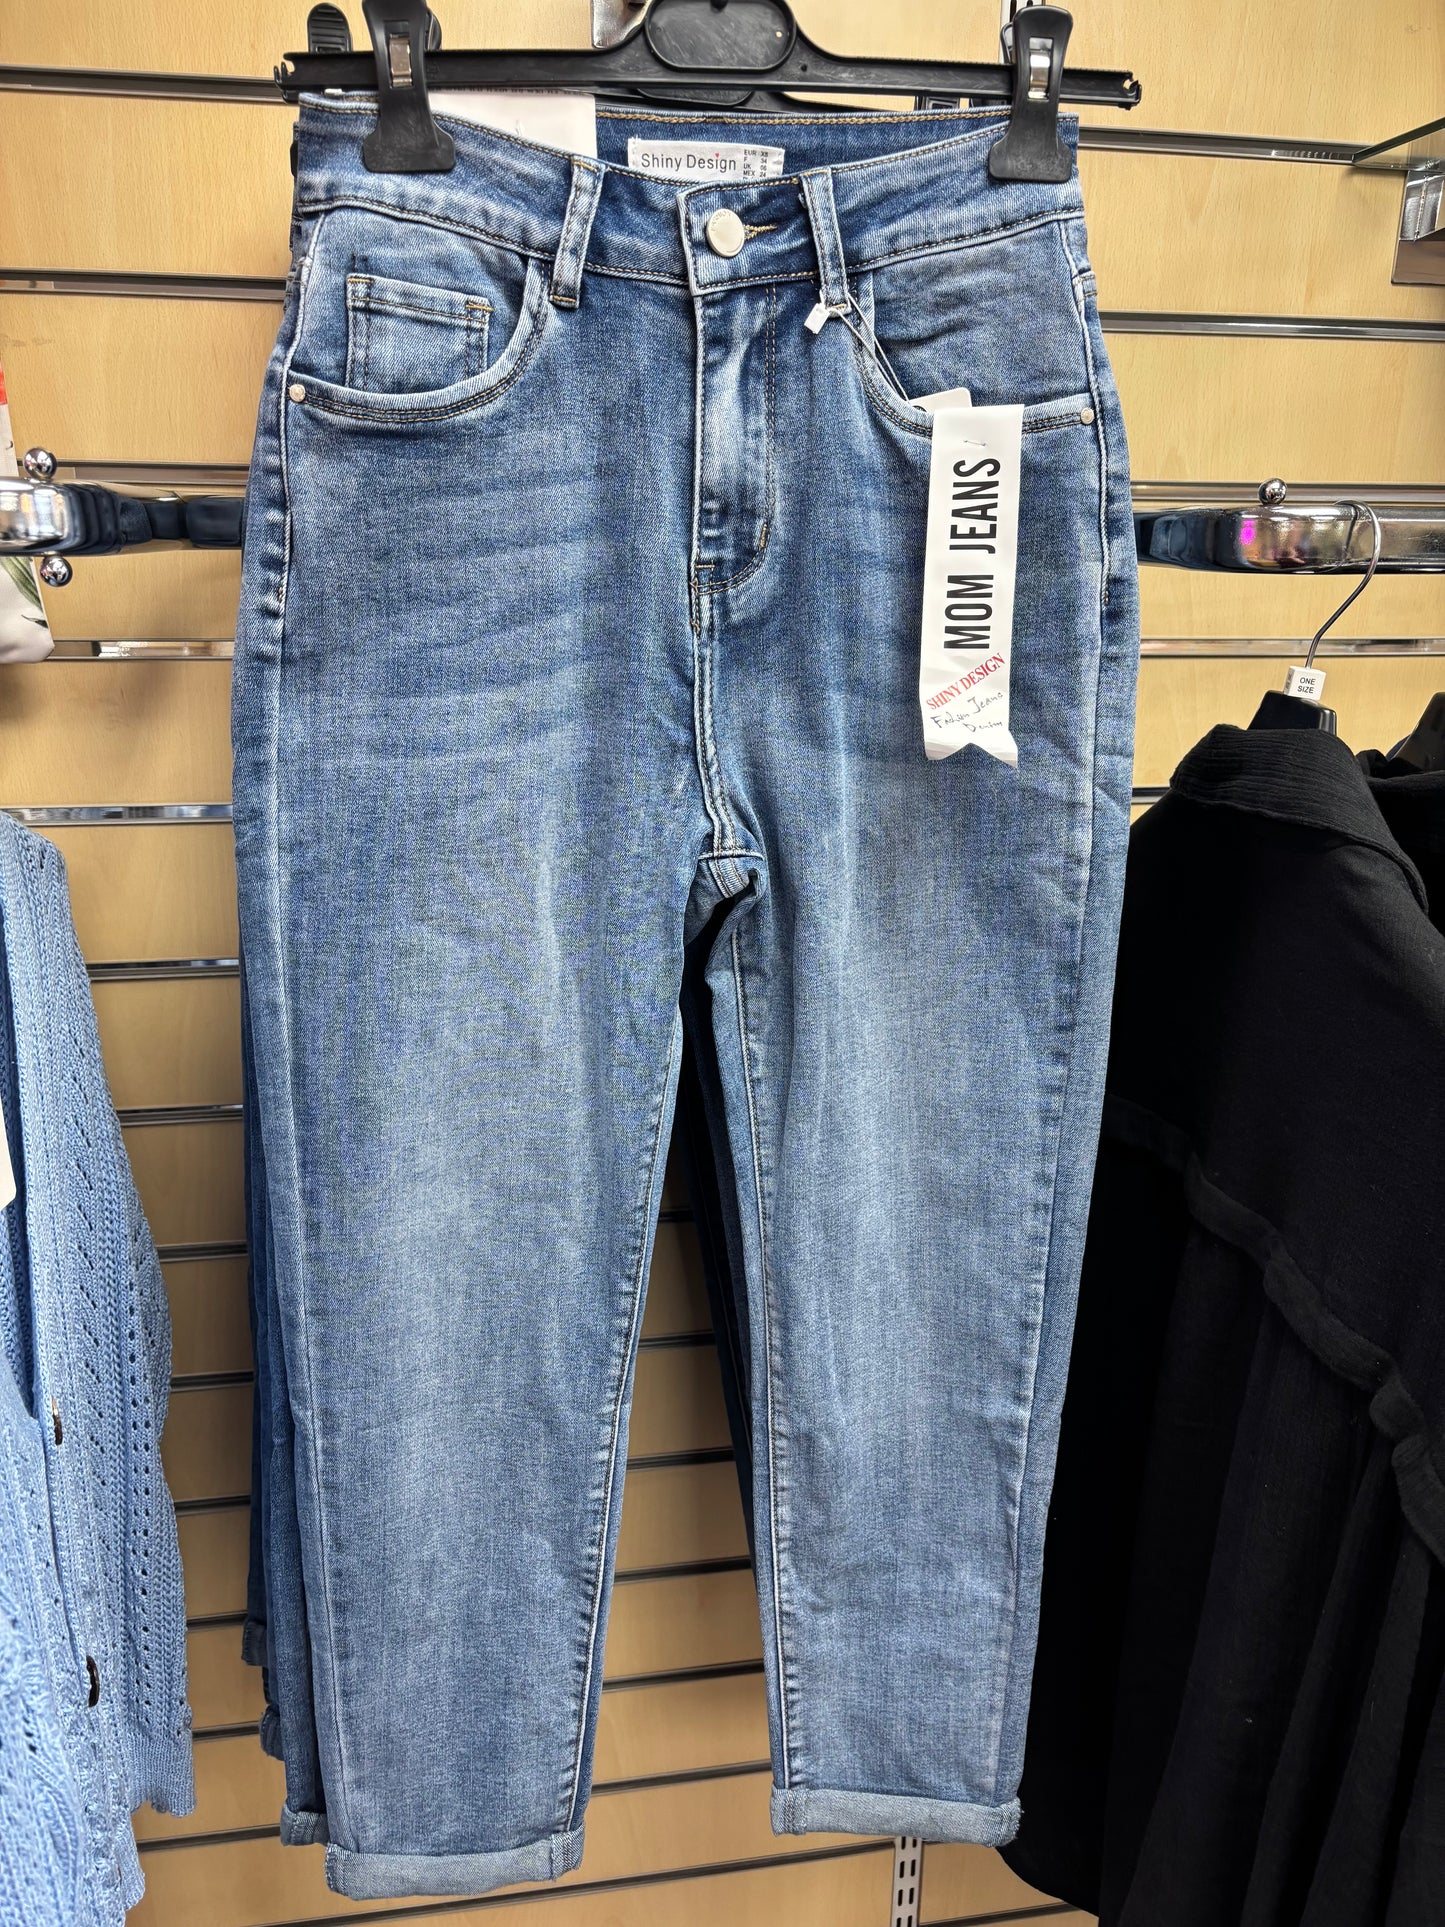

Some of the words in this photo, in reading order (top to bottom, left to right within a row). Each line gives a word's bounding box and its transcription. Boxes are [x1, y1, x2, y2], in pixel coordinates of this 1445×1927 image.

[641, 153, 683, 172] Shiny
[686, 152, 737, 173] Design
[949, 458, 1001, 554] JEANS
[943, 575, 994, 649] MOM
[926, 682, 962, 710] SHINY
[959, 652, 1006, 691] DESIGN
[1297, 685, 1315, 694] SIZE
[1299, 677, 1316, 685] ONE
